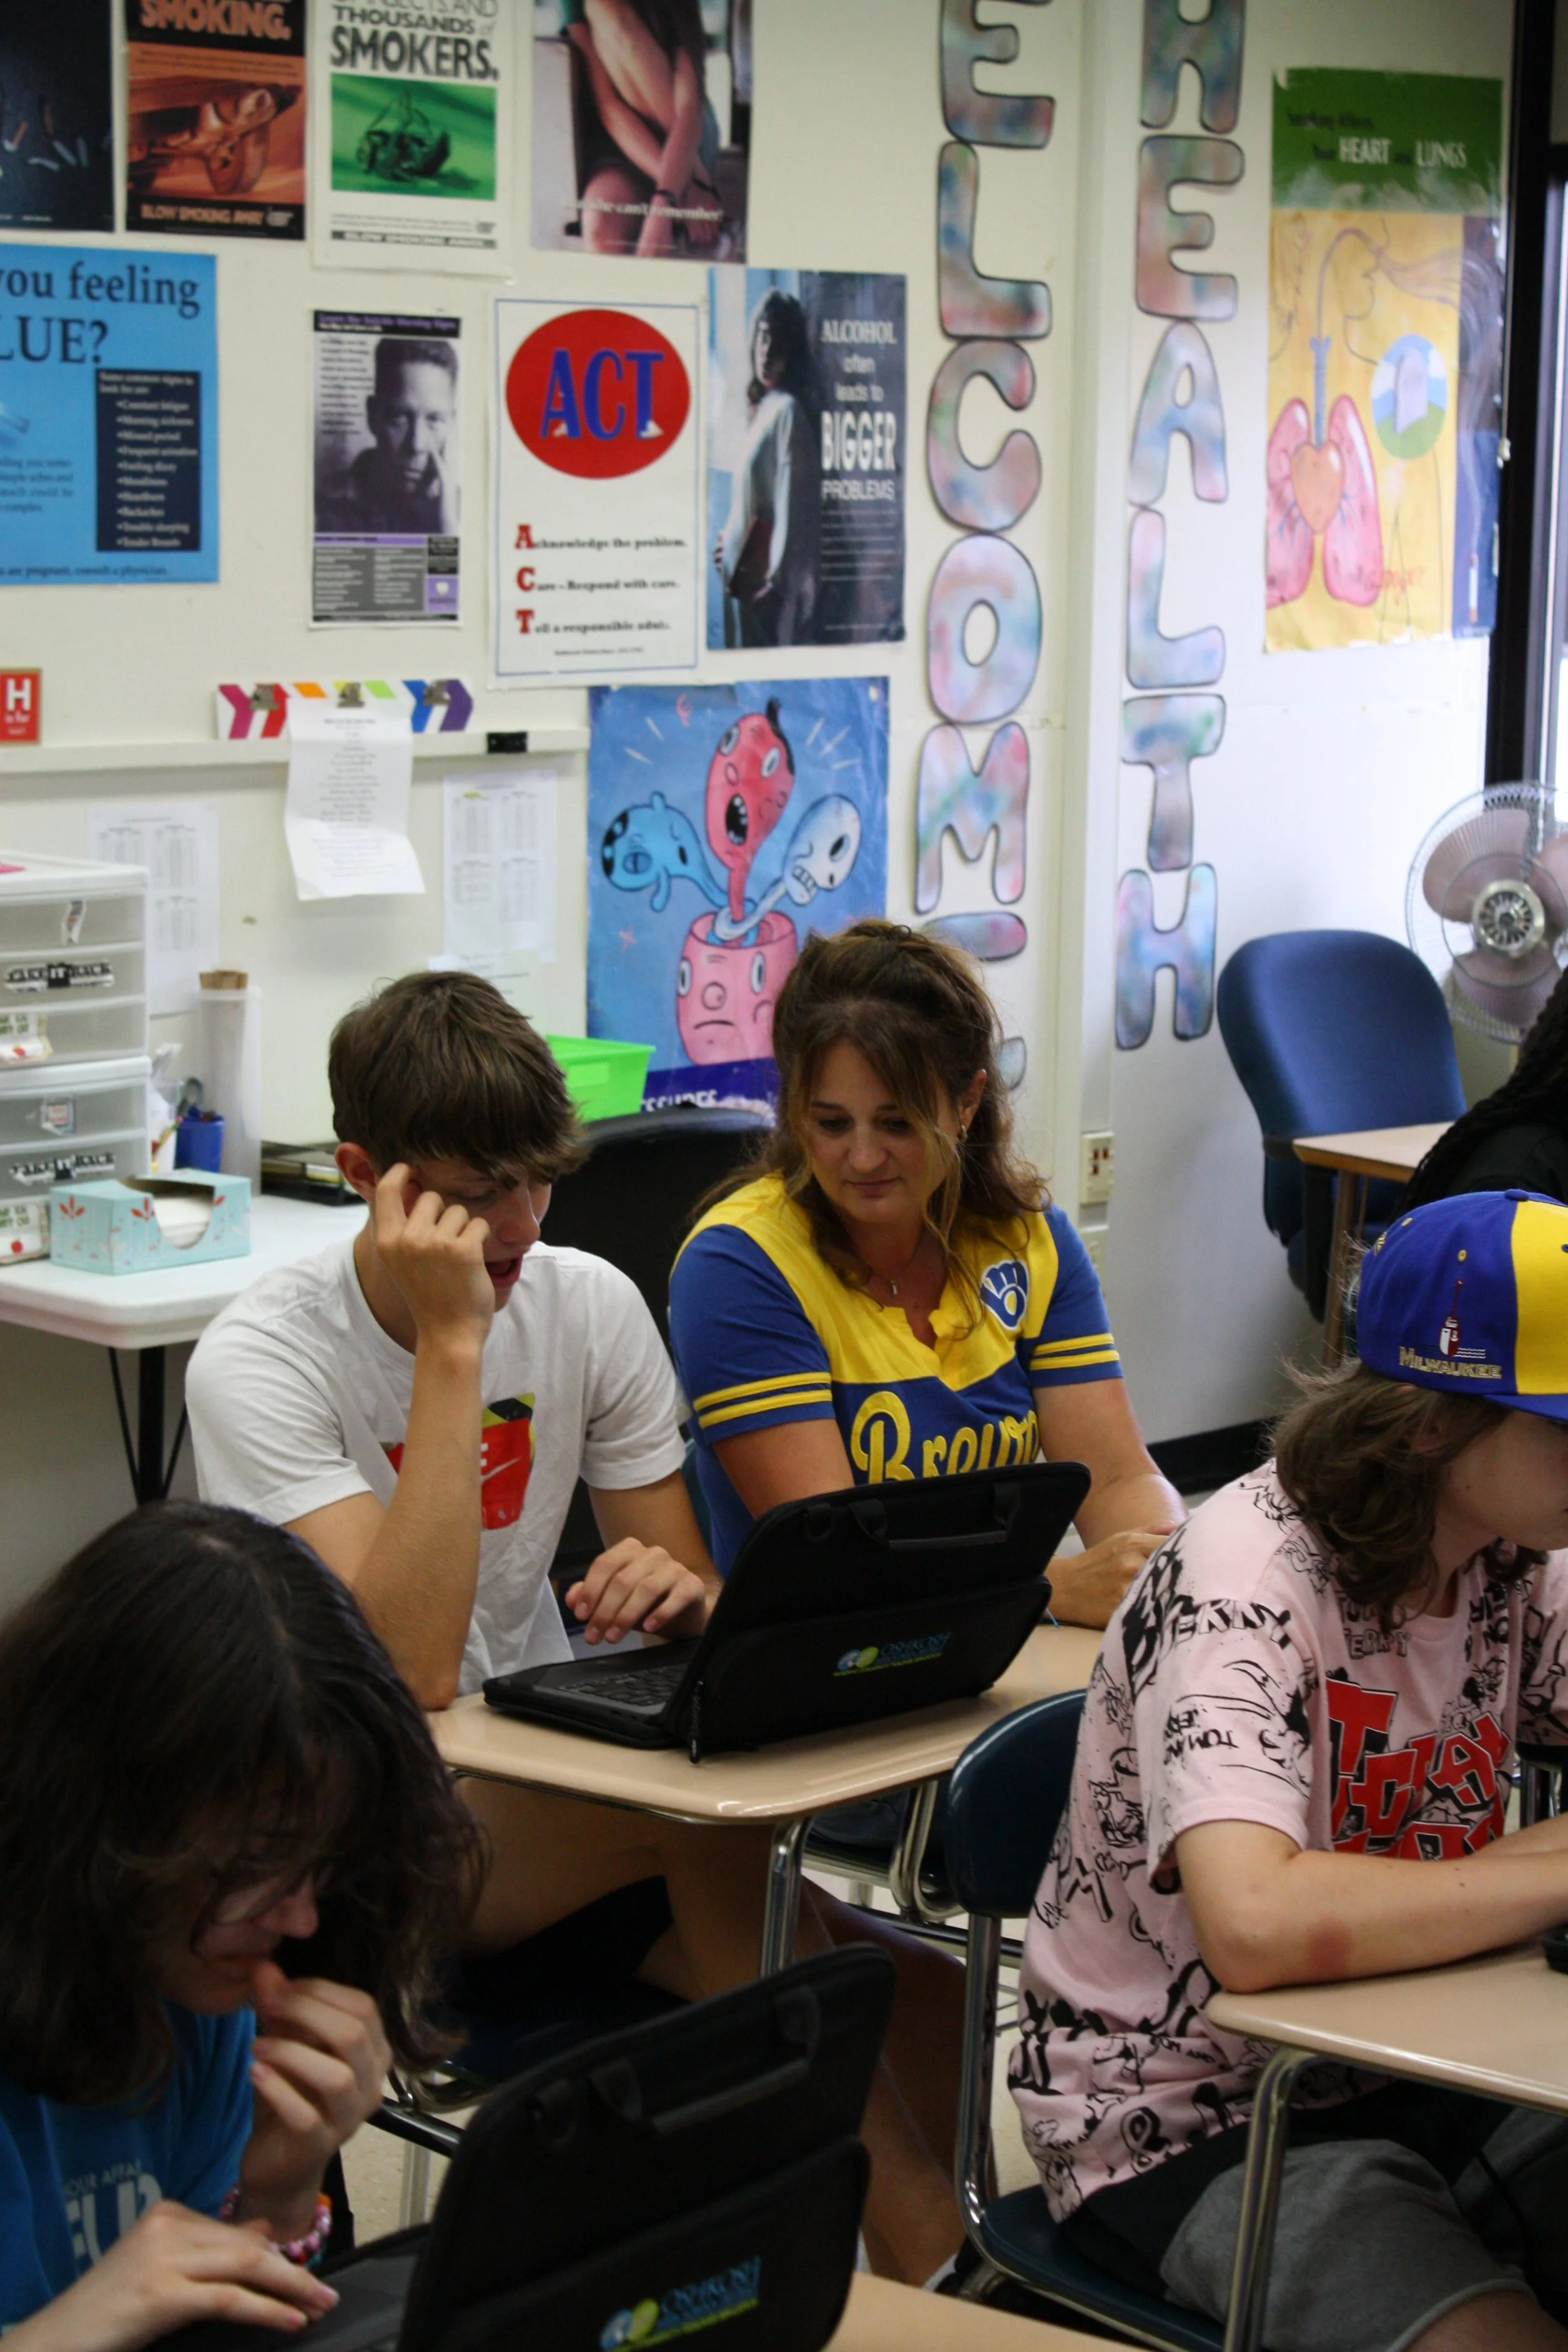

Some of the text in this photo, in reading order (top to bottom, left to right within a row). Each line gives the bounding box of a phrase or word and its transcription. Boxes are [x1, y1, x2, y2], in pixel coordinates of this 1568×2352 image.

[140, 0, 292, 41] SMOKING.
[332, 5, 475, 34] THOUSANDS
[331, 24, 500, 81] SMOKERS.
[1338, 135, 1392, 166] HEART
[1416, 139, 1468, 169] LUNGS
[0, 259, 200, 320] ou feeling
[820, 319, 898, 344] ALCOHOL
[539, 347, 665, 440] ACT
[820, 410, 897, 472] BIGGER
[821, 479, 896, 501] PROBLEMS
[612, 537, 631, 549] the
[634, 536, 687, 551] problem.
[567, 580, 620, 593] Respond
[623, 580, 648, 589] with
[563, 620, 633, 635] responsible
[6, 677, 31, 711] H
